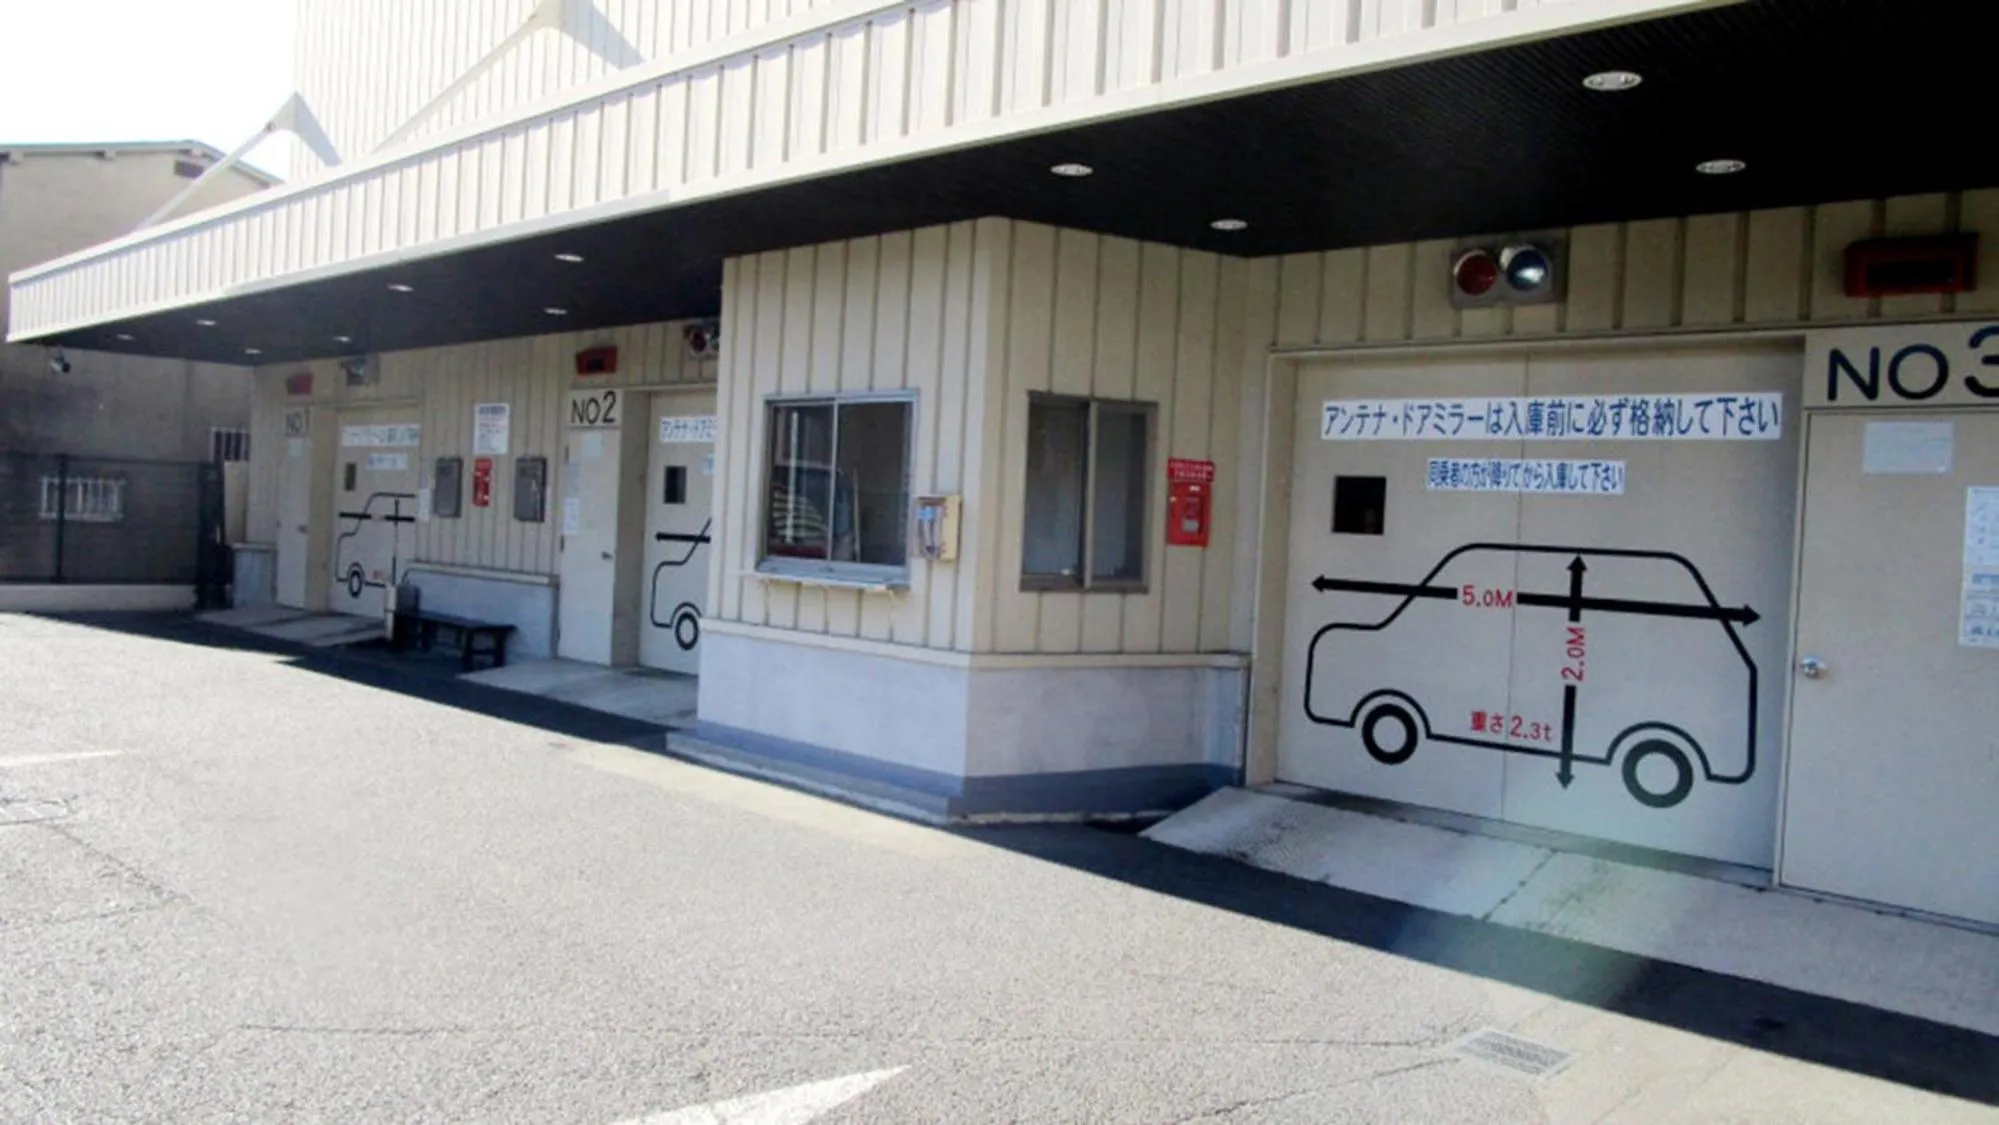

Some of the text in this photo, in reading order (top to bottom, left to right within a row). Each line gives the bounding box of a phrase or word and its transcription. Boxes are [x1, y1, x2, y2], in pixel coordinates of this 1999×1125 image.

[570, 390, 617, 424] NO2
[1325, 397, 1779, 437] アンテナ・ドアミラーは入庫前に必ず格納して下さい
[1462, 584, 1514, 608] 5.0M
[1560, 626, 1586, 682] 2.0M
